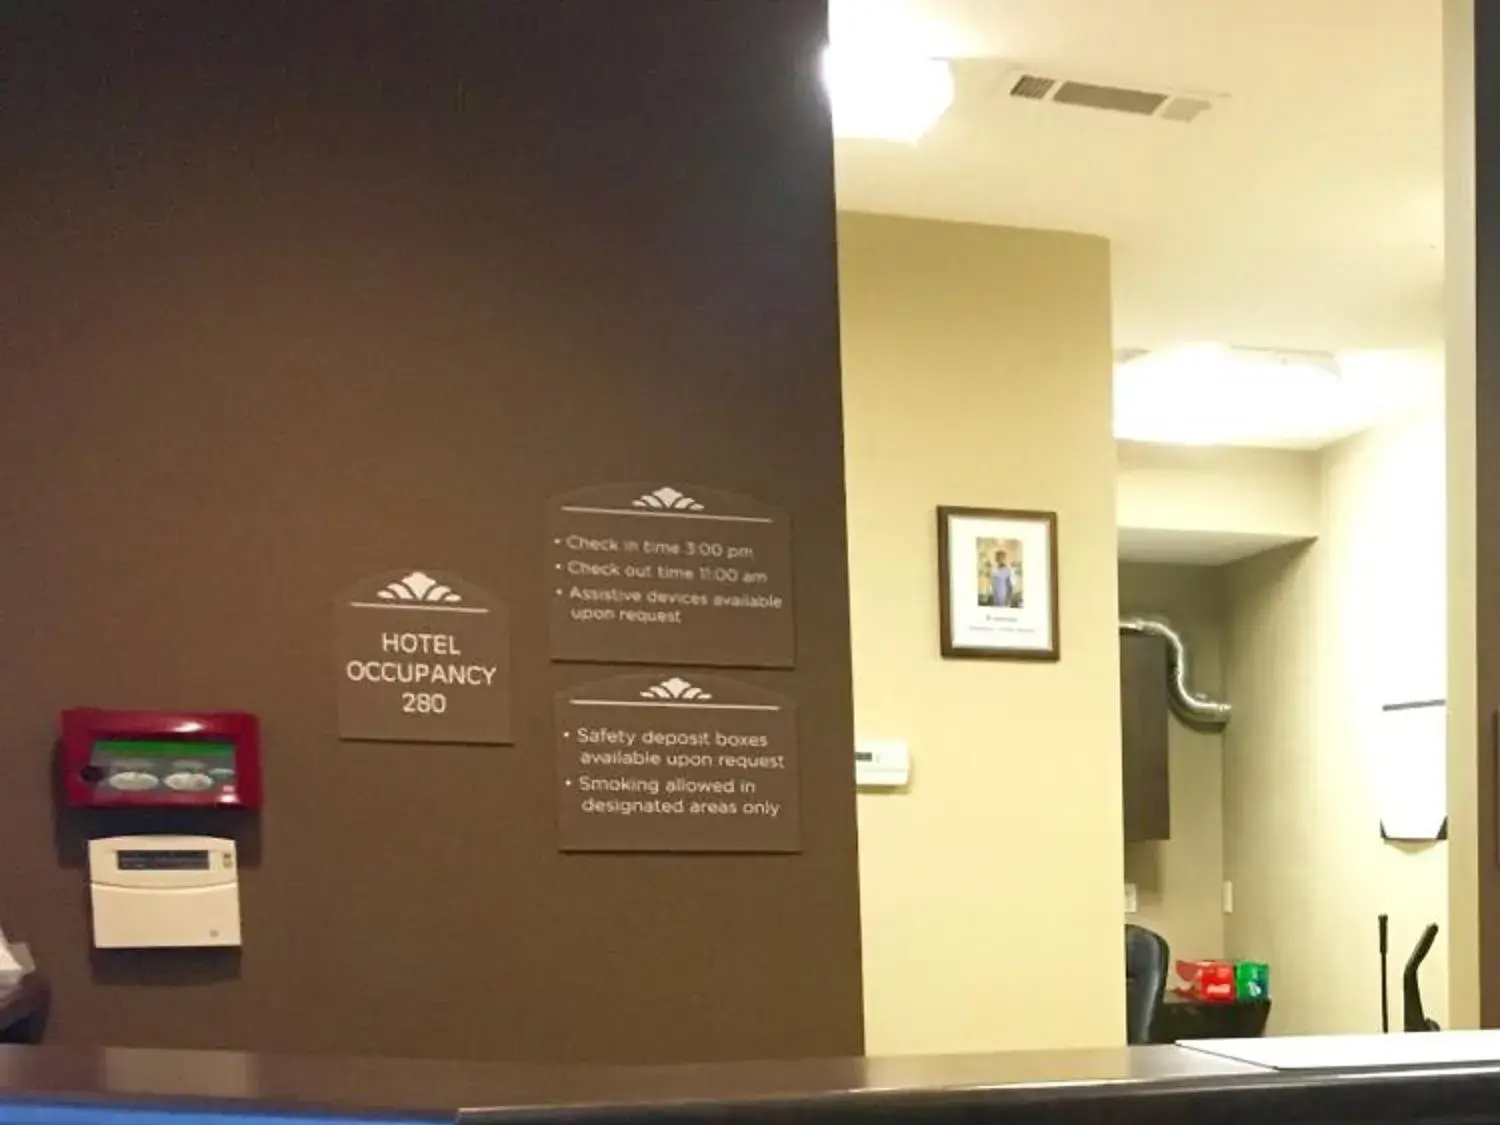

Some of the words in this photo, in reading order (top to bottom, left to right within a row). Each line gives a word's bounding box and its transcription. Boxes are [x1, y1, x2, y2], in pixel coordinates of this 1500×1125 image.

[566, 535, 618, 551] Check
[624, 540, 639, 552] in
[643, 540, 679, 554] time
[727, 544, 752, 560] pm
[567, 560, 619, 576] Check
[625, 566, 652, 578] out
[657, 566, 694, 581] time
[744, 571, 767, 583] am
[570, 586, 641, 601] Assistive
[647, 589, 708, 605] devices
[714, 594, 783, 608] available
[570, 607, 615, 620] upon
[620, 609, 681, 624] request
[382, 632, 461, 655] HOTEL
[346, 660, 497, 686] OCCUPANCY
[401, 692, 446, 713] 280
[577, 728, 636, 746] Safety
[641, 730, 710, 746] deposit
[715, 731, 768, 747] boxes
[580, 751, 661, 765] available
[666, 755, 712, 767] upon
[718, 755, 784, 769] request
[579, 776, 659, 794] Smoking
[665, 778, 734, 792] allowed
[740, 779, 756, 792] in
[581, 797, 684, 815] designated
[690, 801, 737, 813] areas
[743, 800, 780, 816] only
